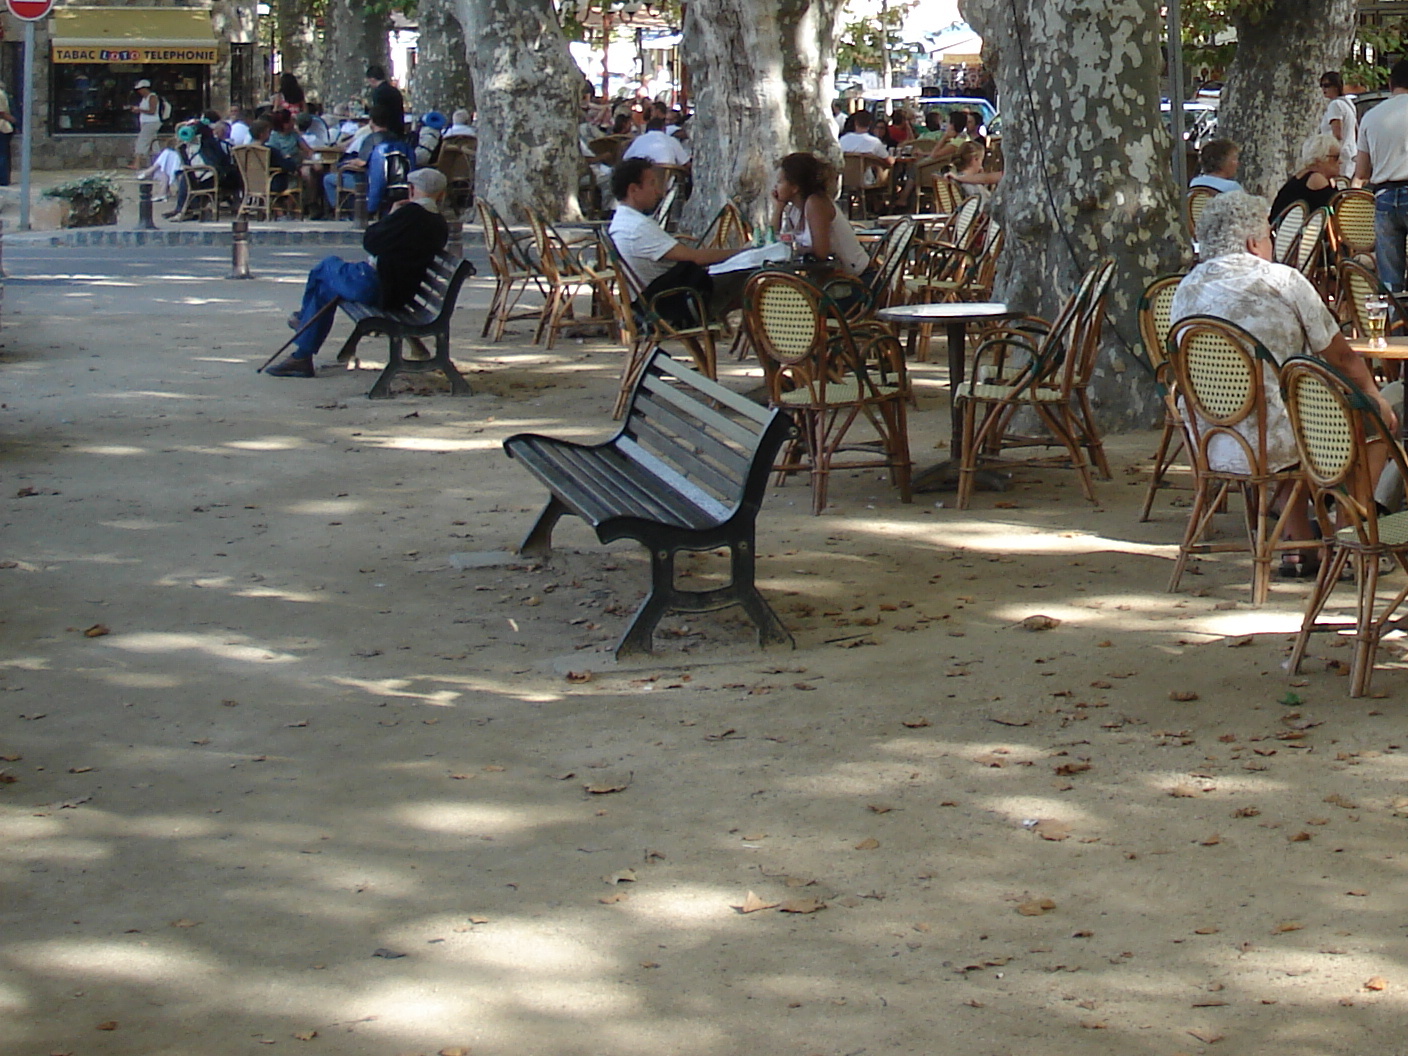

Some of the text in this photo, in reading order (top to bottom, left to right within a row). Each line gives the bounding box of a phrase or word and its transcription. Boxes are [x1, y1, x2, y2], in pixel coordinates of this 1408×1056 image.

[56, 50, 215, 61] TABAC LOTO TELEPHONIE
